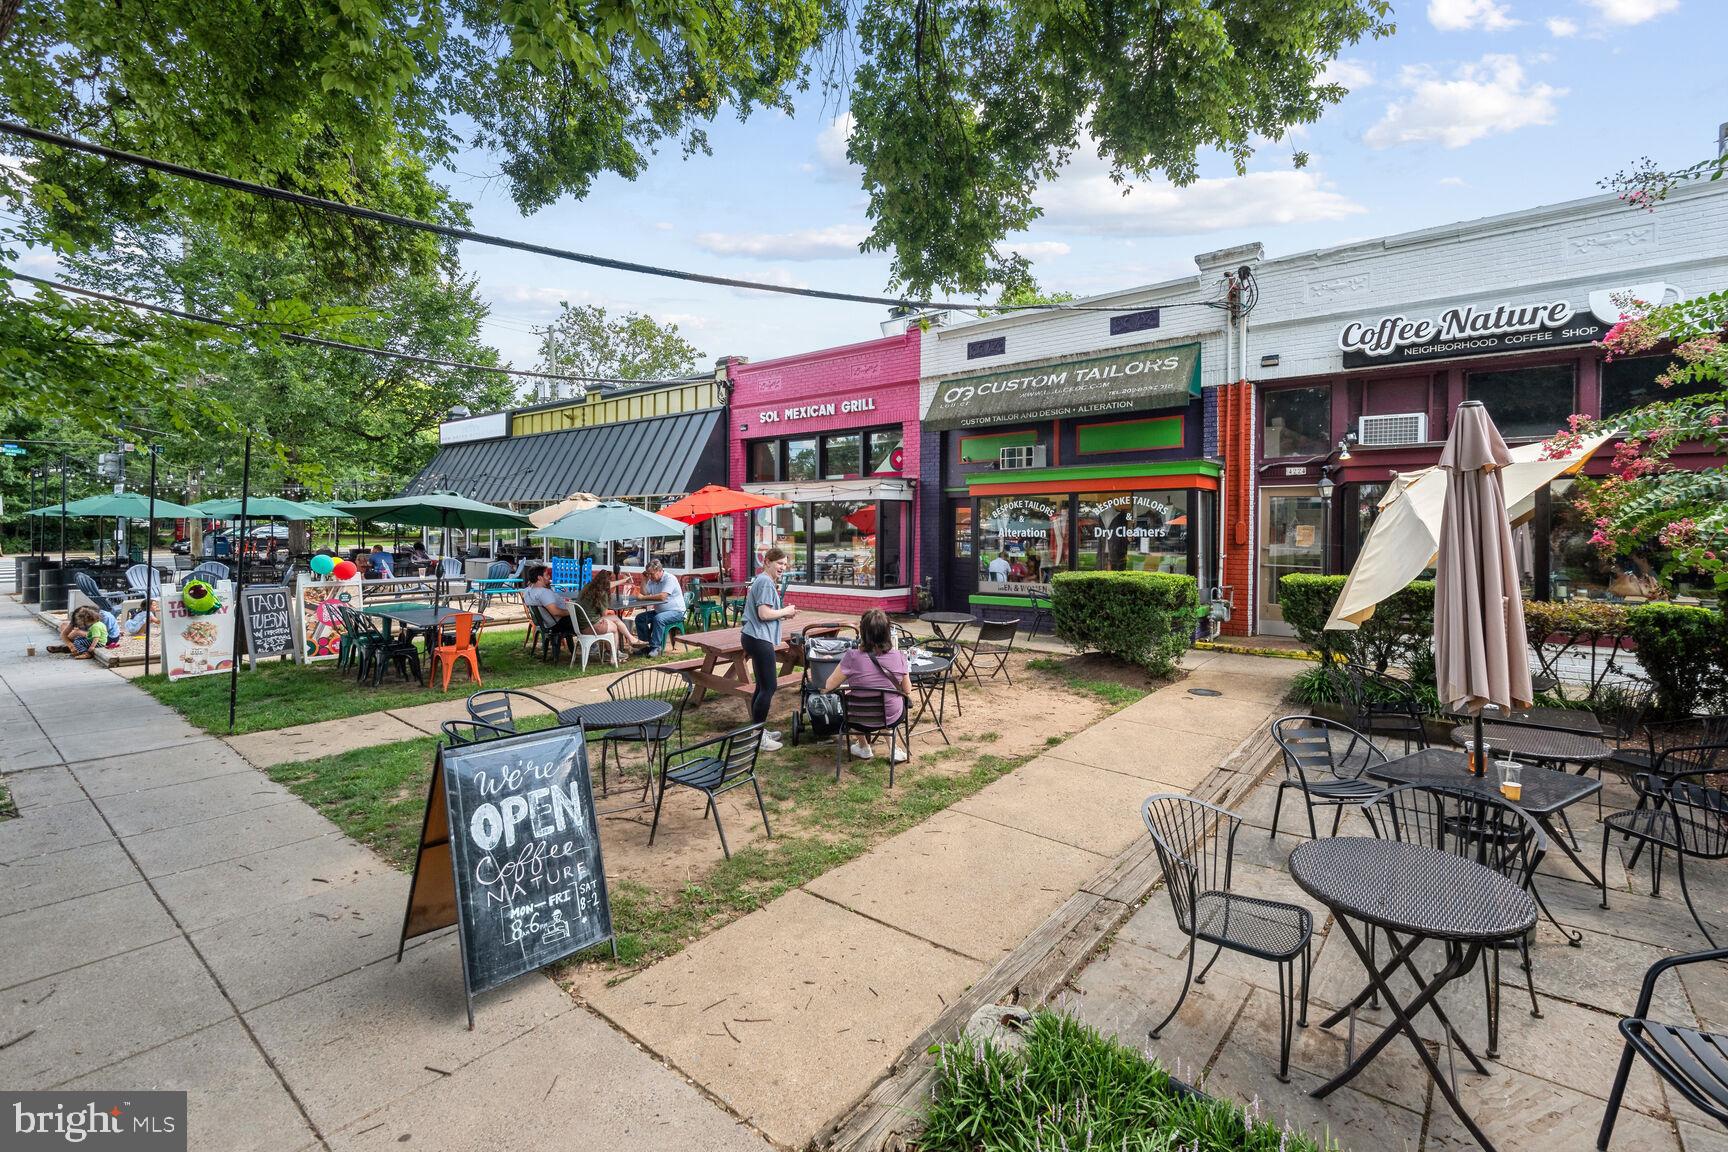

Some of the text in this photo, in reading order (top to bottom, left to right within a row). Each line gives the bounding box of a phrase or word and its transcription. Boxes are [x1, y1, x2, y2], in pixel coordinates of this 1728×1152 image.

[1340, 301, 1572, 353] Coffee Nature
[1404, 326, 1599, 355] NEIGHBORHOOD COFFEE SHOP
[977, 372, 1067, 395] CUSTOM
[1076, 357, 1179, 382] TAILORS
[759, 398, 876, 423] SOL MEXICAN GRILL
[961, 401, 1134, 426] CUSTOM TAILOR AND DESIGN ALTERATION
[991, 500, 1054, 518] BESPOKE TAILORS
[1092, 496, 1169, 515] BESPOKE TAILORS
[1125, 512, 1133, 521] &
[998, 527, 1047, 538] Alteration
[1094, 526, 1166, 540] Dry Cleaners
[248, 593, 286, 613] TACO
[474, 760, 560, 796] We're
[470, 781, 583, 850] OPEN
[476, 840, 590, 885] Coffee
[487, 861, 588, 908] NATURE
[580, 880, 597, 894] SAT
